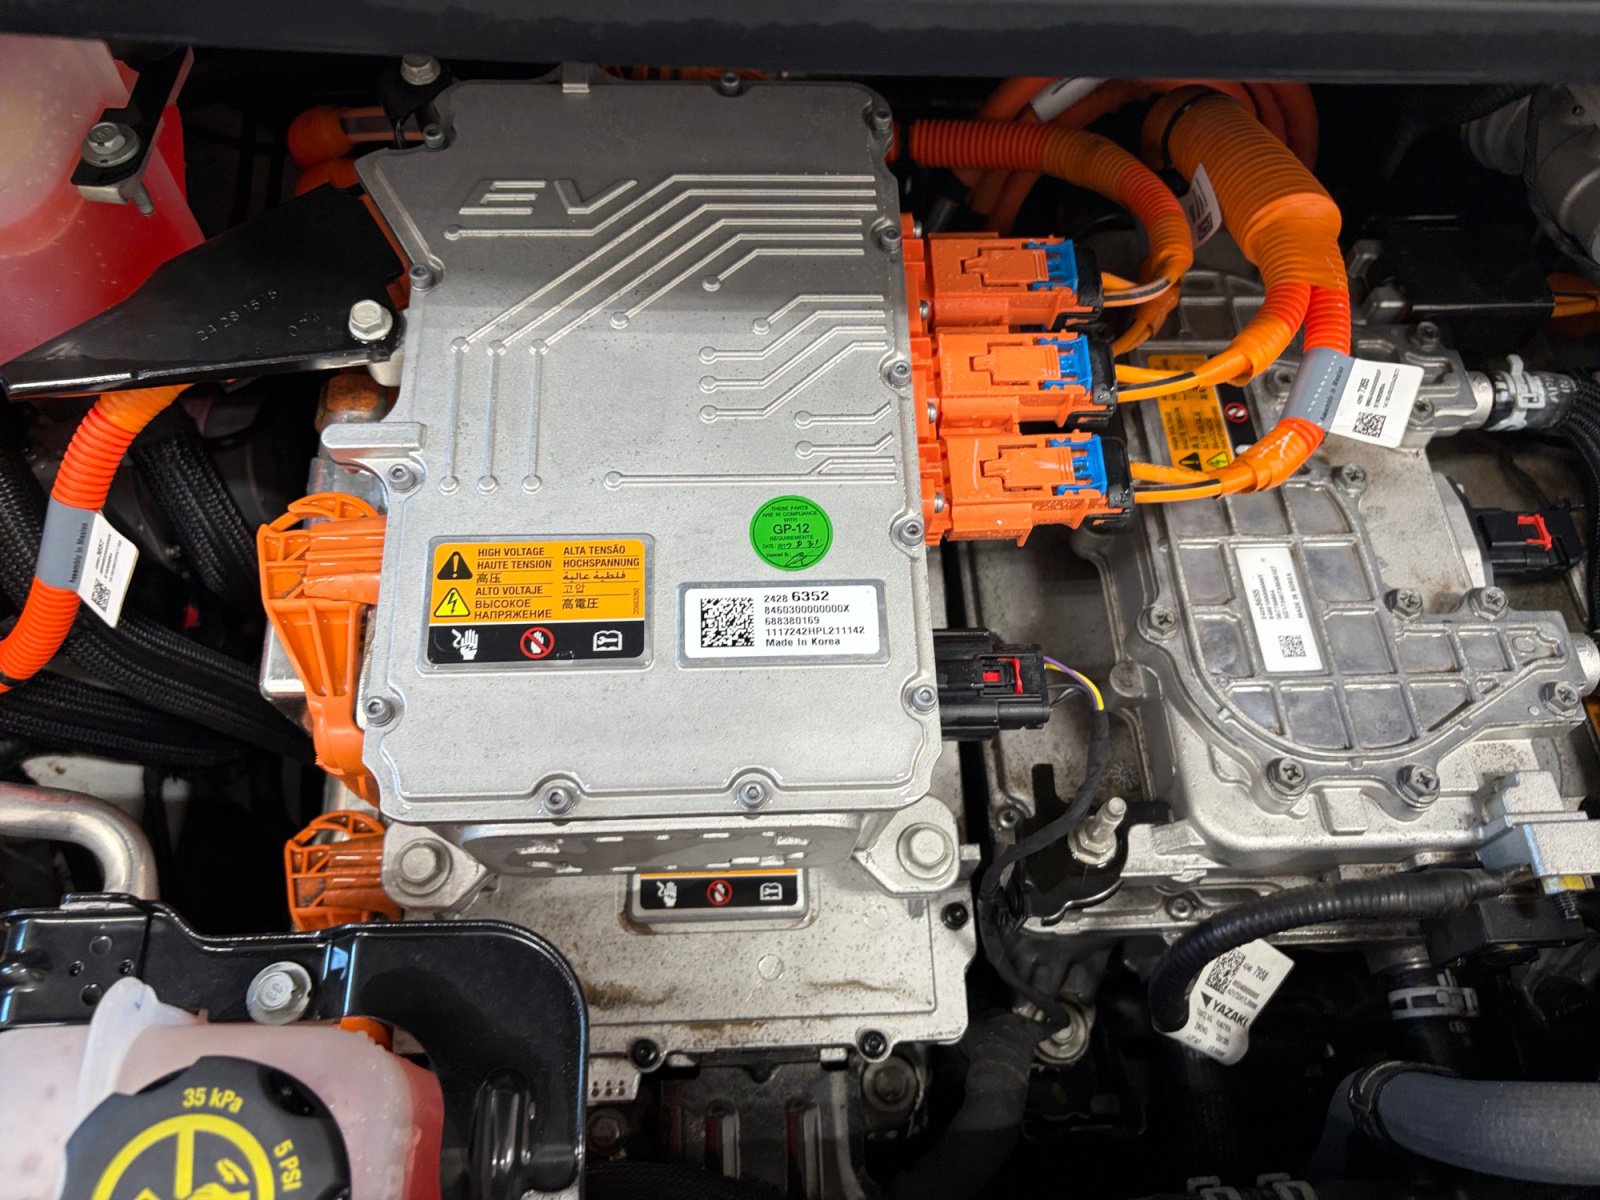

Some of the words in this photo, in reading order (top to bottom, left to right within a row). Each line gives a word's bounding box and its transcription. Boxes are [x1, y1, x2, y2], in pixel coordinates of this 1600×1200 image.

[457, 178, 638, 215] EV
[773, 523, 810, 534] GP-12
[478, 548, 500, 557] HIGH
[504, 547, 545, 556] VOLTAGE
[563, 546, 586, 555] ALTA
[589, 544, 626, 554] TENSÃO
[477, 560, 508, 570] HAUTE
[511, 560, 552, 568] TENSION
[563, 558, 640, 568] HOCHSPANNUNG
[476, 572, 501, 583] 高压
[1285, 572, 1297, 592] KOREA
[475, 586, 499, 596] ALTO
[502, 585, 543, 595] VOLTAJE
[562, 583, 584, 594] 고압
[763, 594, 788, 603] 2428
[791, 590, 830, 602] 6352
[475, 599, 531, 609] ВЫСОКОЕ
[562, 597, 599, 609] 高電圧
[474, 609, 552, 620] НАПРЯЖЕНИЕ
[764, 604, 850, 614] 8460300000000X
[1294, 601, 1304, 619] MADE
[765, 616, 820, 626] 688380169
[766, 626, 865, 637] 1117242HPL211142
[766, 638, 794, 647] Made
[797, 638, 808, 646] In
[811, 637, 841, 646] Korea
[1212, 999, 1249, 1028] YAZAKI
[182, 1087, 206, 1108] 35
[209, 1087, 244, 1113] kPa
[273, 1139, 294, 1158] 5
[279, 1155, 303, 1192] PSI
